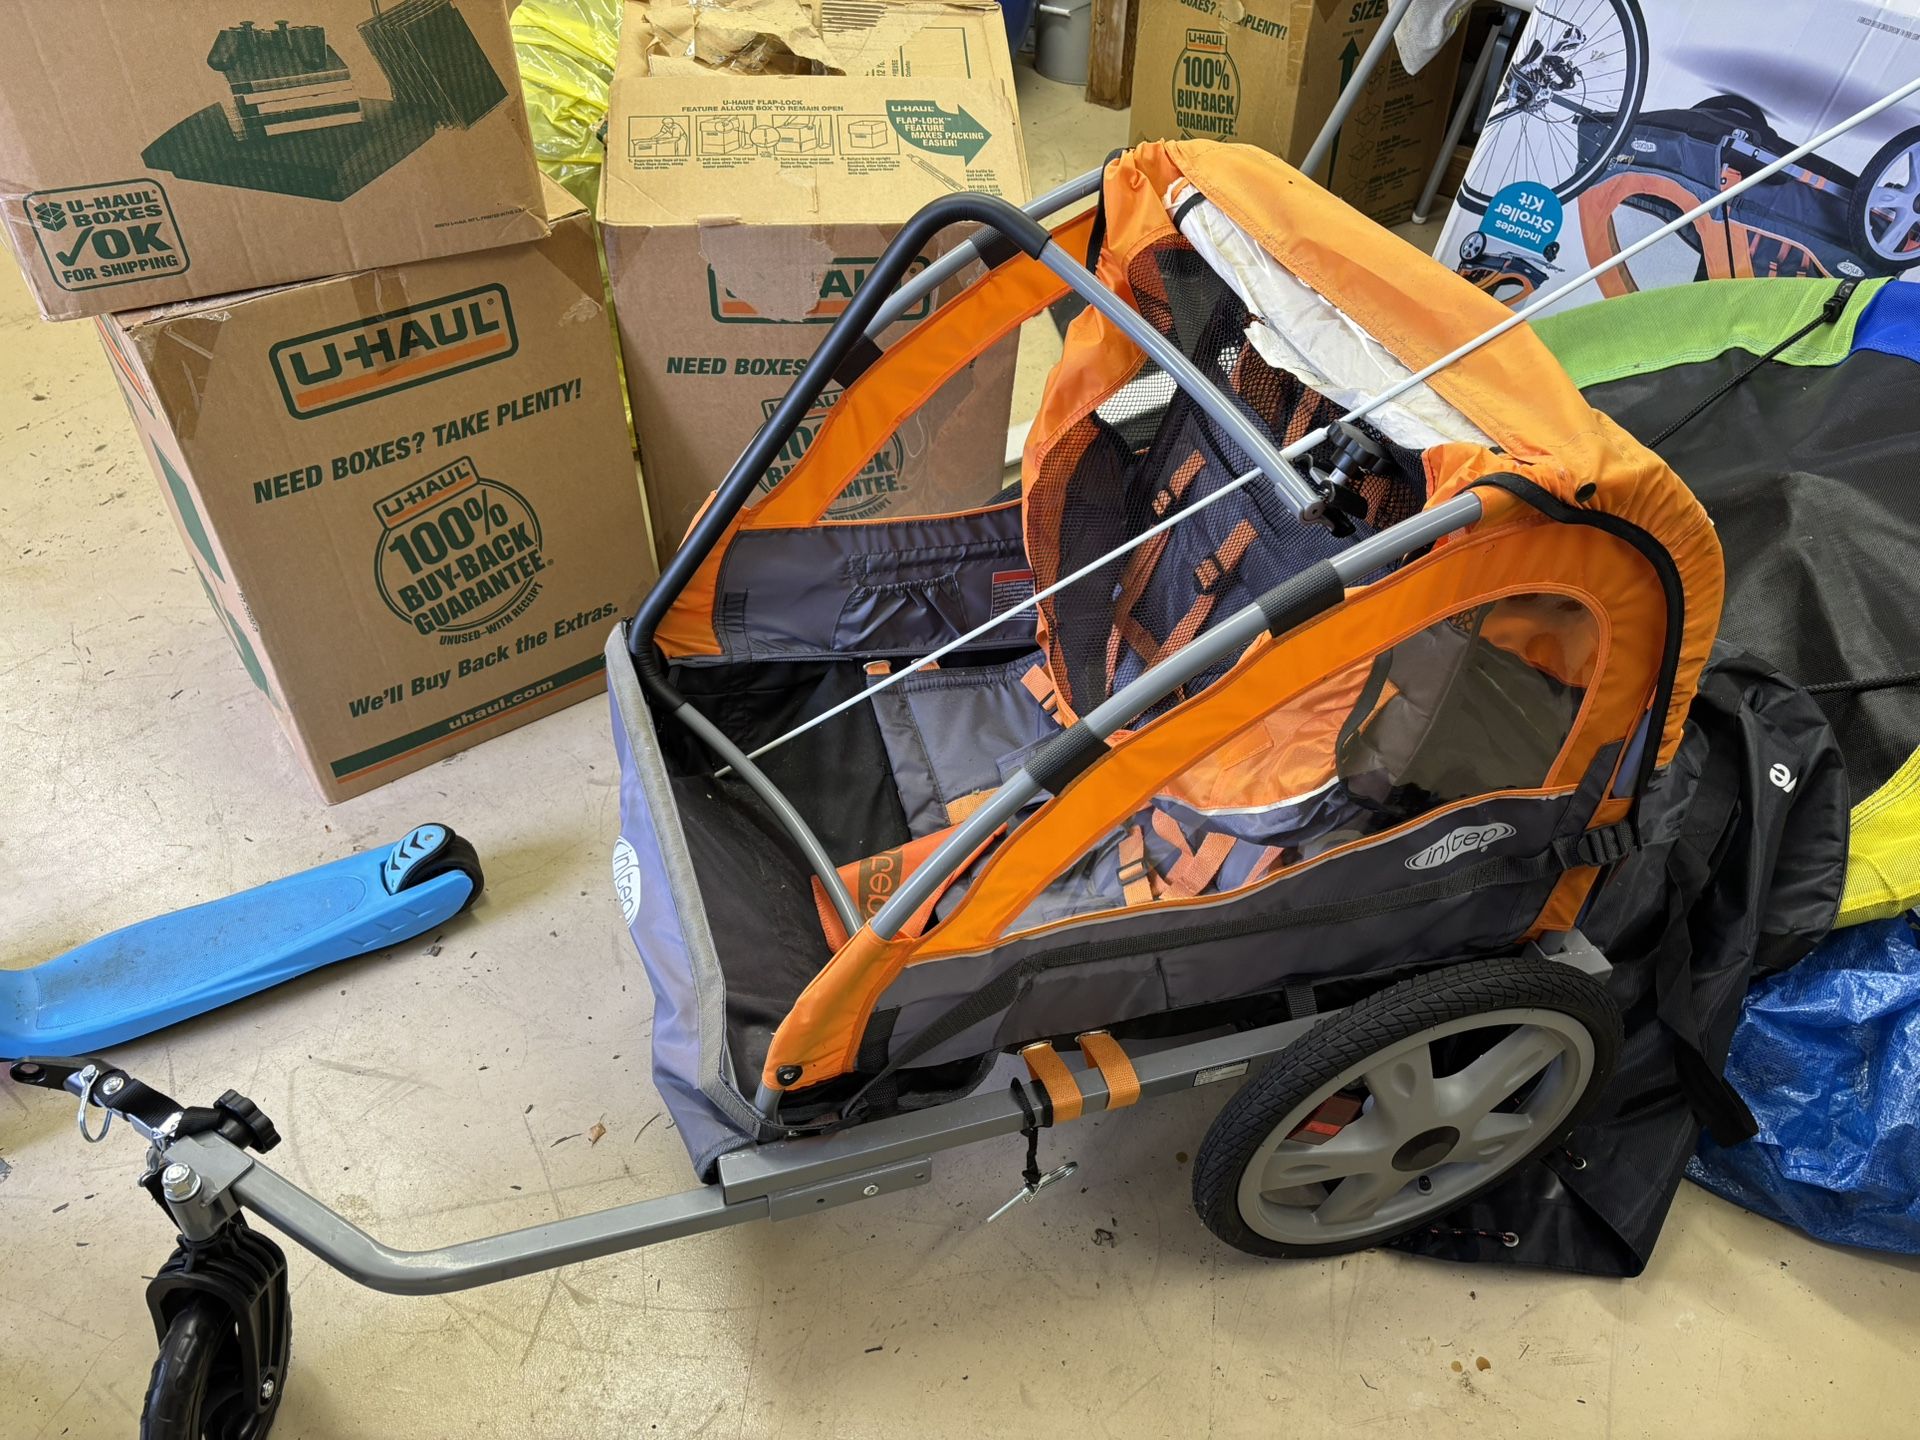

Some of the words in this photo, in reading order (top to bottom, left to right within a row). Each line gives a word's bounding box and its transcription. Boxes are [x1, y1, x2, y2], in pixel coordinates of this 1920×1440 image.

[1349, 0, 1383, 23] SIZE
[1188, 32, 1224, 46] U-HAUL
[1245, 14, 1287, 40] PLENTY!
[1183, 56, 1229, 90] 100%
[891, 105, 935, 113] U-HAUL
[1177, 88, 1234, 115] BUY-BACK
[904, 124, 945, 132] FEATURE
[911, 131, 943, 139] MAKES
[945, 132, 985, 140] PACKING
[922, 139, 958, 147] EASIER!
[65, 190, 157, 213] U-HAUL
[1518, 191, 1545, 212] Kit
[72, 204, 163, 228] BOXES
[1494, 202, 1555, 234] Stroller
[91, 222, 173, 260] OK
[1494, 219, 1541, 244] Includes
[62, 267, 98, 283] FOR
[100, 254, 179, 278] SHIPPING
[289, 301, 501, 386] U-HAUL
[666, 357, 727, 375] NEED
[253, 465, 323, 504] NEED
[332, 431, 426, 482] BOXES?
[432, 411, 490, 448] TAKE
[497, 378, 582, 427] PLENTY!
[381, 465, 470, 518] U-HAUL
[388, 489, 508, 575] 100%
[398, 521, 535, 613] BUY-BACK
[349, 684, 404, 719] We'll
[410, 671, 451, 701] Buy
[457, 645, 509, 680] Back
[515, 629, 548, 655] the
[555, 602, 619, 640] Extras.
[448, 678, 555, 732] uhaul.com
